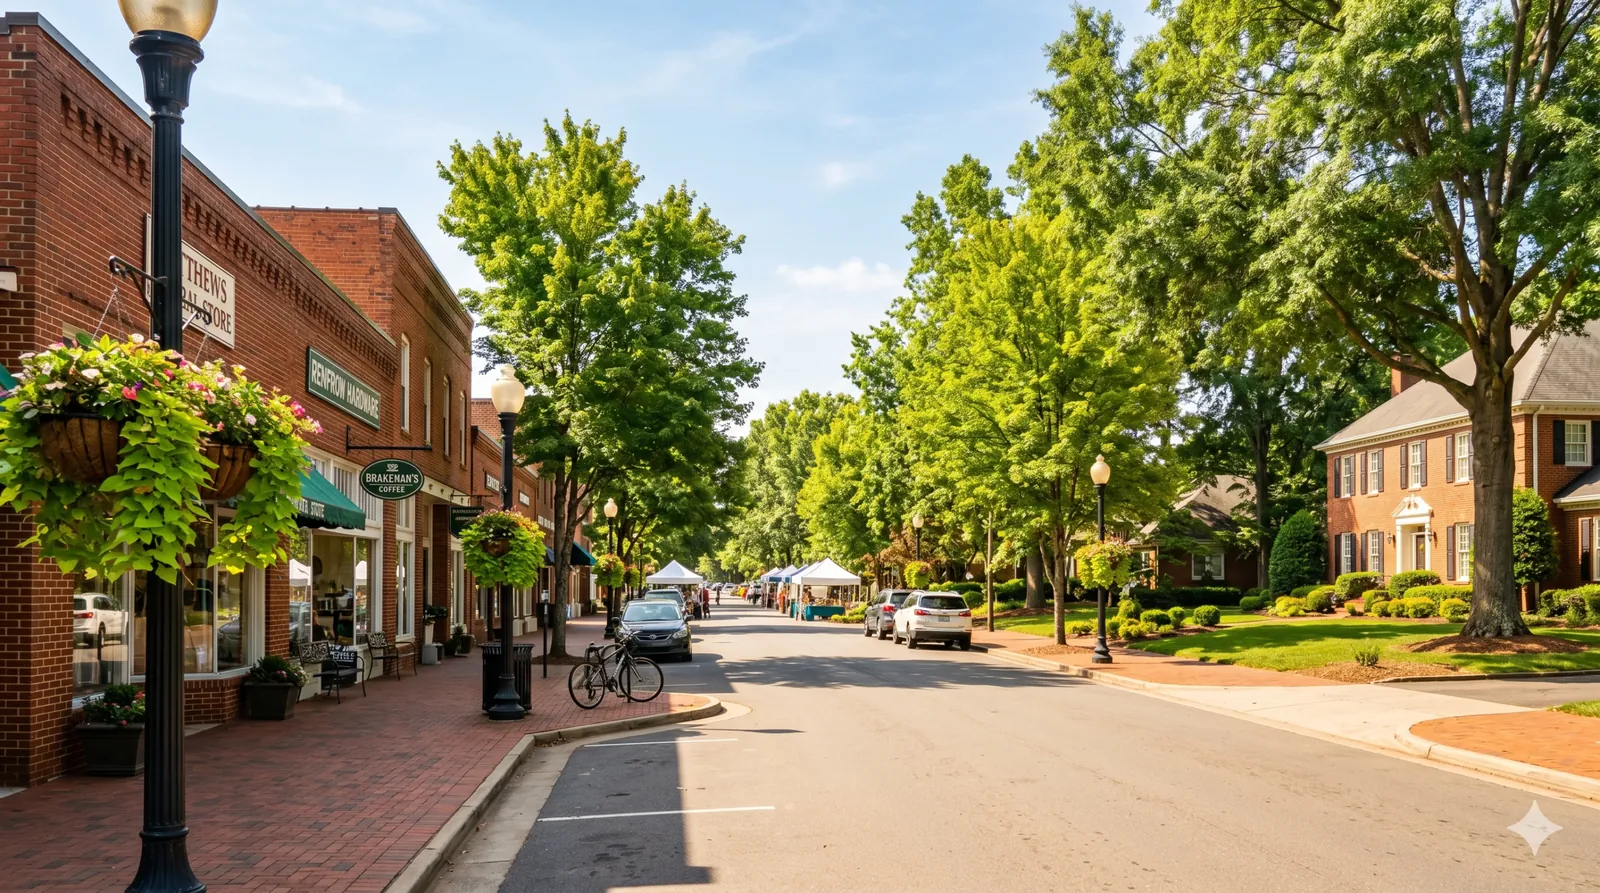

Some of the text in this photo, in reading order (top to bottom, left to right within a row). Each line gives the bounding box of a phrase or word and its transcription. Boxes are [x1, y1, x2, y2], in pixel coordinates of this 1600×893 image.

[182, 254, 227, 303] THEWS
[203, 300, 232, 335] STORE
[311, 358, 379, 419] RENFROW HARDWARE
[366, 473, 419, 483] BRAKEMAN'S
